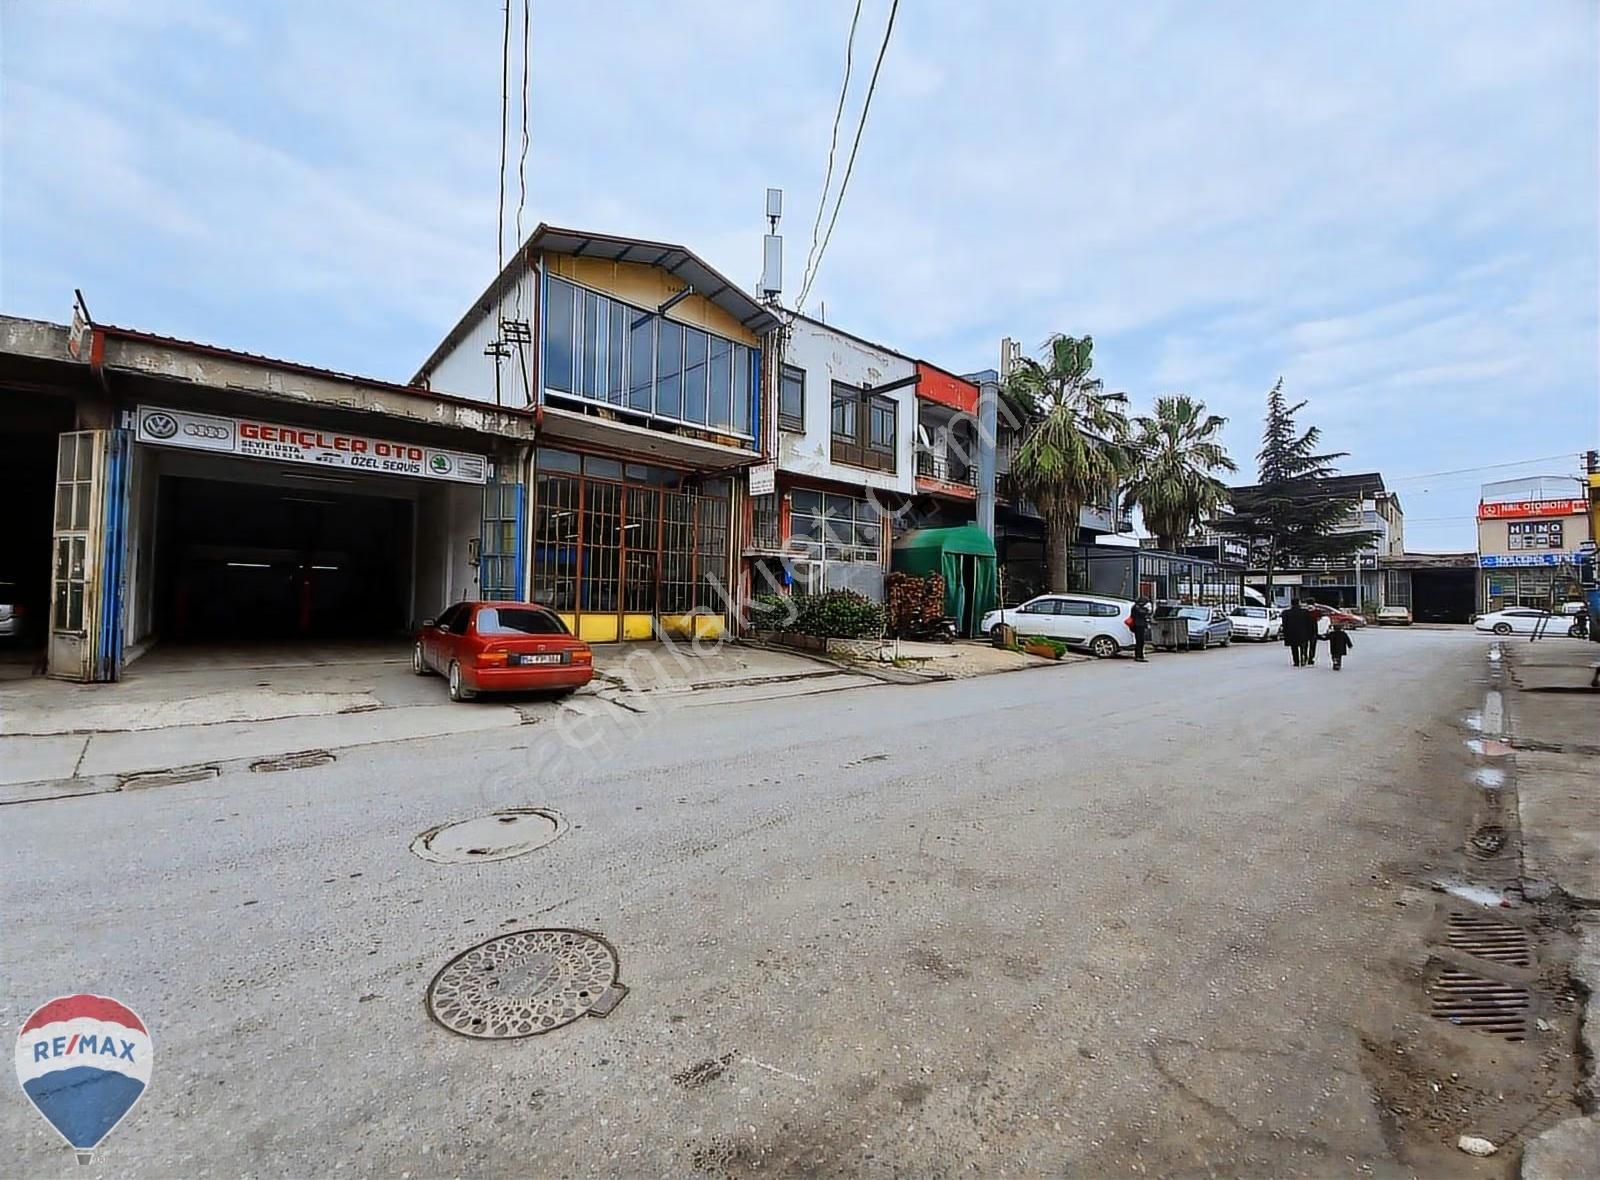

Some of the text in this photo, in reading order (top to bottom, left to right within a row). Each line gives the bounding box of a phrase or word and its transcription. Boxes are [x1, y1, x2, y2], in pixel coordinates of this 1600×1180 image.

[241, 424, 422, 461] GENÇLER OTO
[275, 445, 300, 453] USTA
[351, 453, 379, 469] ÖZEL
[382, 460, 420, 473] SERVİS
[1510, 524, 1560, 534] HINO
